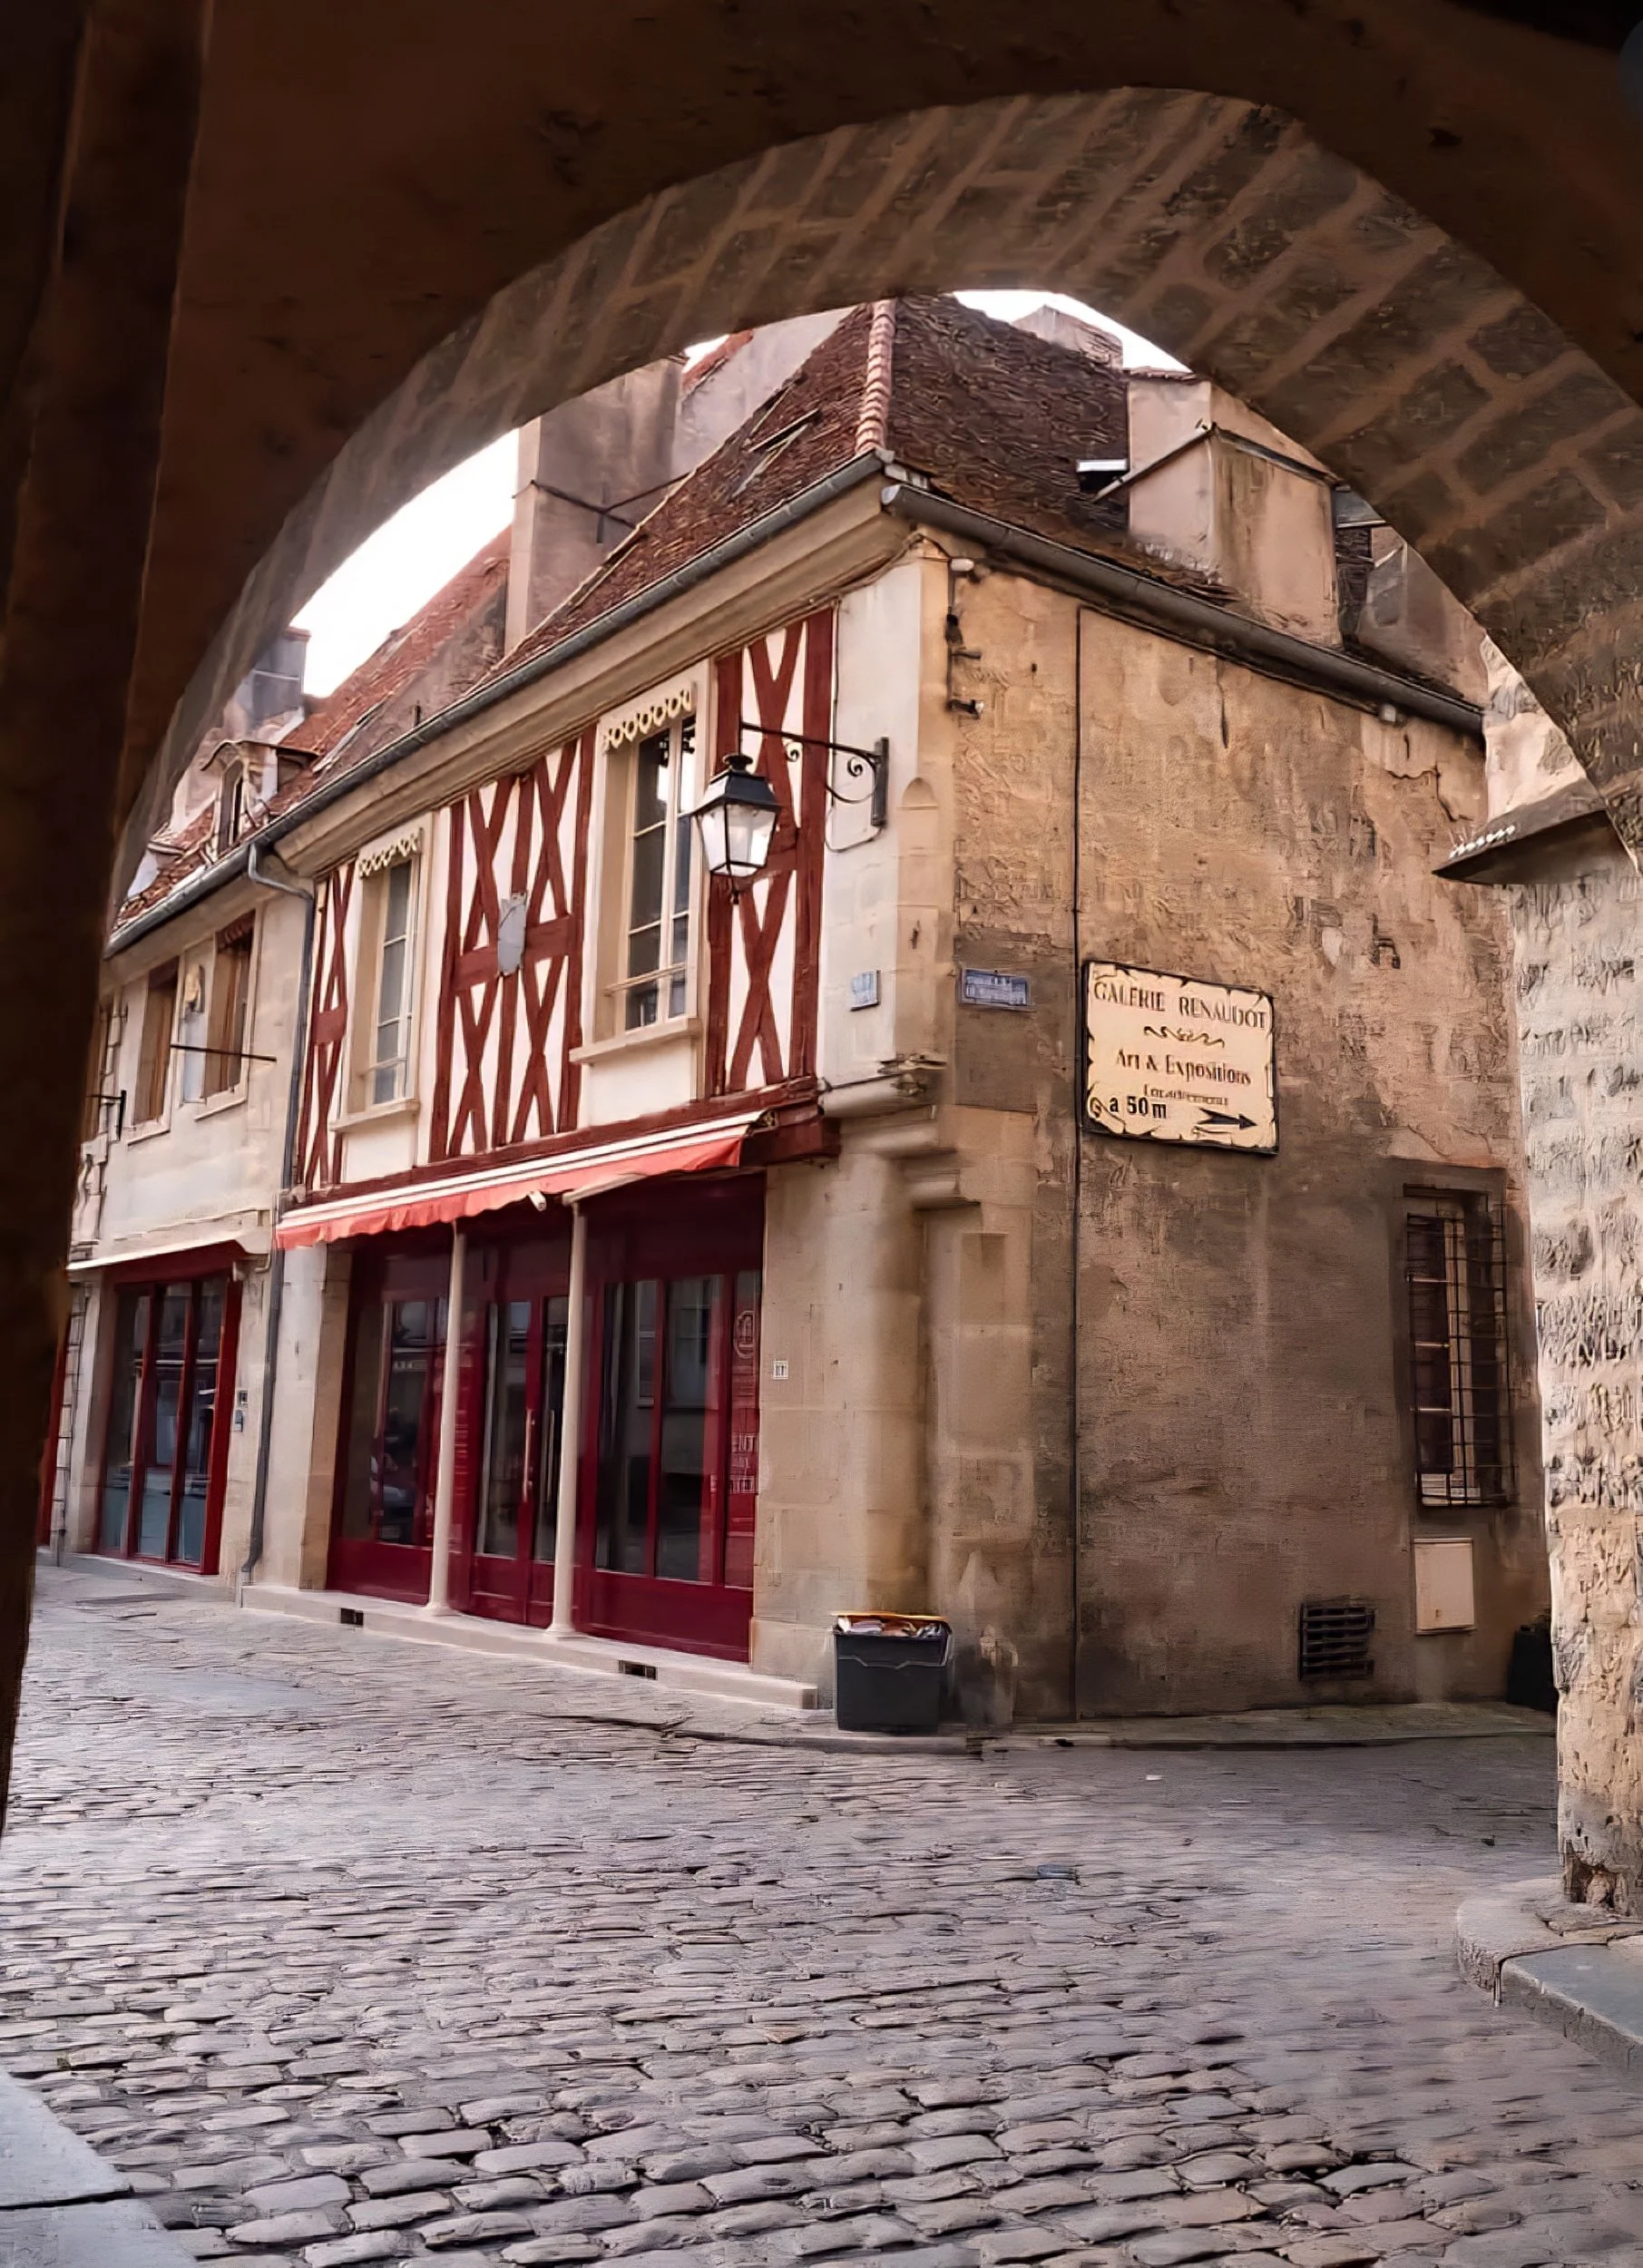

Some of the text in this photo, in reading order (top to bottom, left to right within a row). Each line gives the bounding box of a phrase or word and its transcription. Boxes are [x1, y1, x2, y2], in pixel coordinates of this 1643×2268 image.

[1093, 981, 1266, 1030] GALERIE RENAUDOT
[1117, 1048, 1140, 1070] Art
[1166, 1053, 1252, 1086] Expositions
[1127, 1095, 1149, 1116] 50
[1151, 1102, 1168, 1119] m
